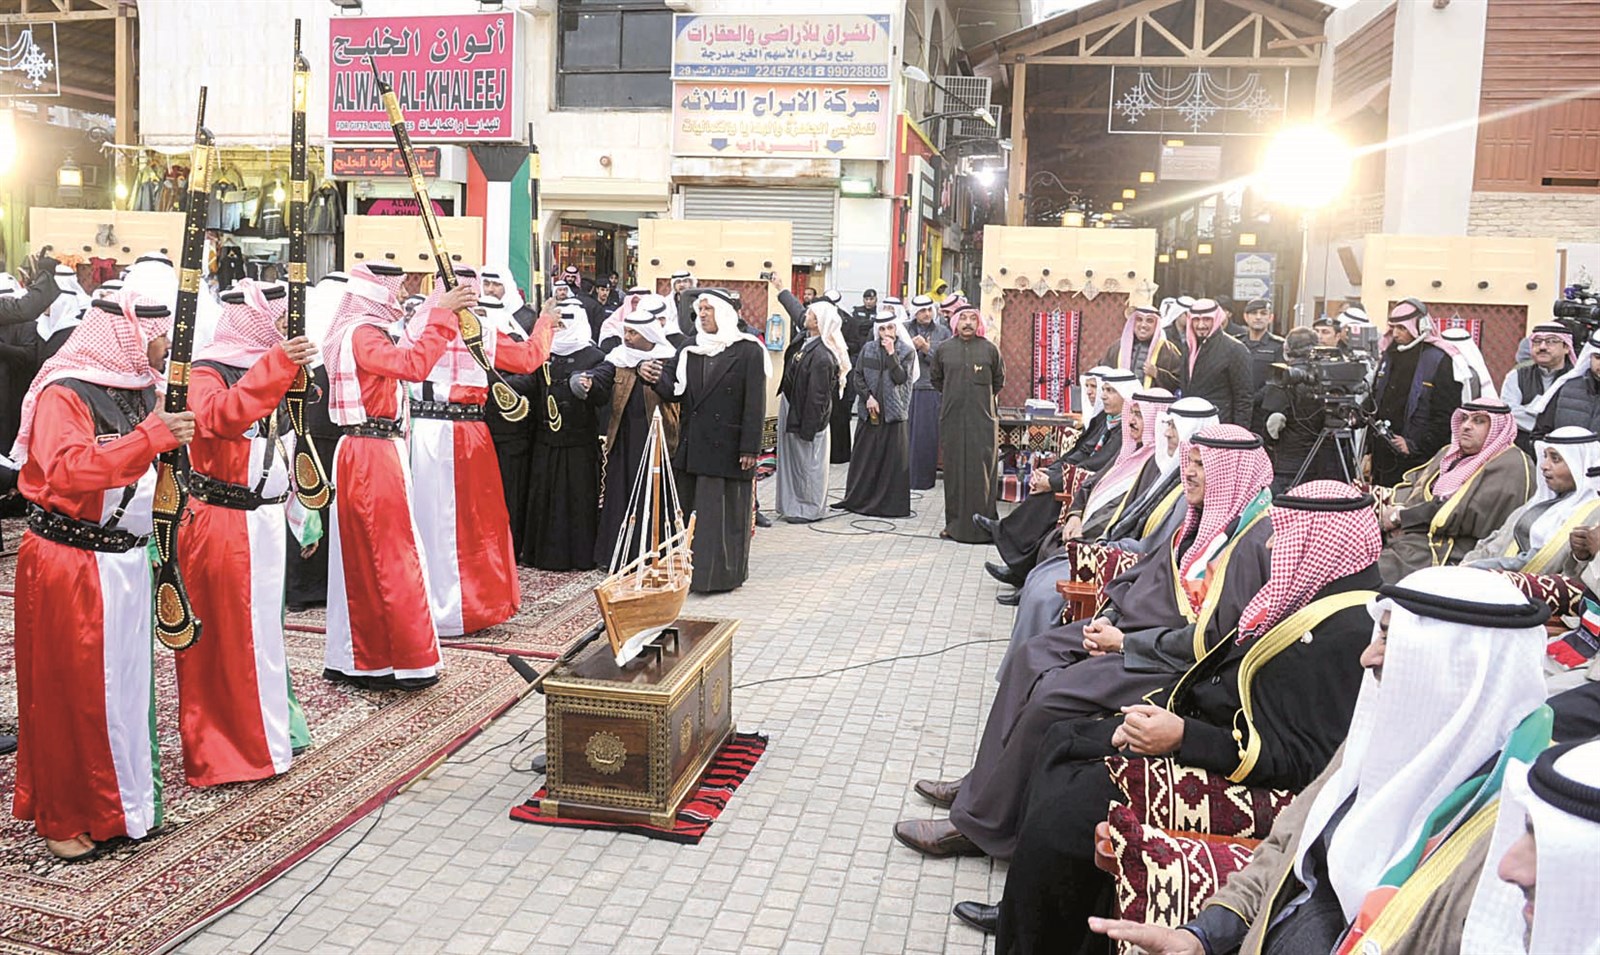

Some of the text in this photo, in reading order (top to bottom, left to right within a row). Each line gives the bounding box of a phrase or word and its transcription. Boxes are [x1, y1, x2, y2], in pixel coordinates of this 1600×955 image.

[333, 18, 505, 64] ألوان الخليج
[687, 23, 755, 46] والعقارات
[823, 23, 877, 46] المشراق
[701, 47, 735, 61] مدرجة
[737, 48, 762, 62] الغير
[801, 47, 833, 61] وشراء
[835, 49, 854, 62] بيع
[692, 65, 710, 75] مكتب
[730, 66, 750, 76] الدور
[755, 66, 813, 77] 22457434
[827, 66, 887, 77] 99028808
[398, 68, 506, 111] AL-KHALEEJ
[753, 90, 817, 117] الابراج
[824, 90, 881, 117] شركة
[336, 122, 348, 131] FOR
[349, 122, 367, 131] GIFTS
[369, 122, 382, 131] AND
[418, 117, 500, 134] للهدايا والكماليات
[333, 154, 367, 174] الخليج
[369, 151, 394, 171] ألوان
[391, 199, 416, 207] ALWA
